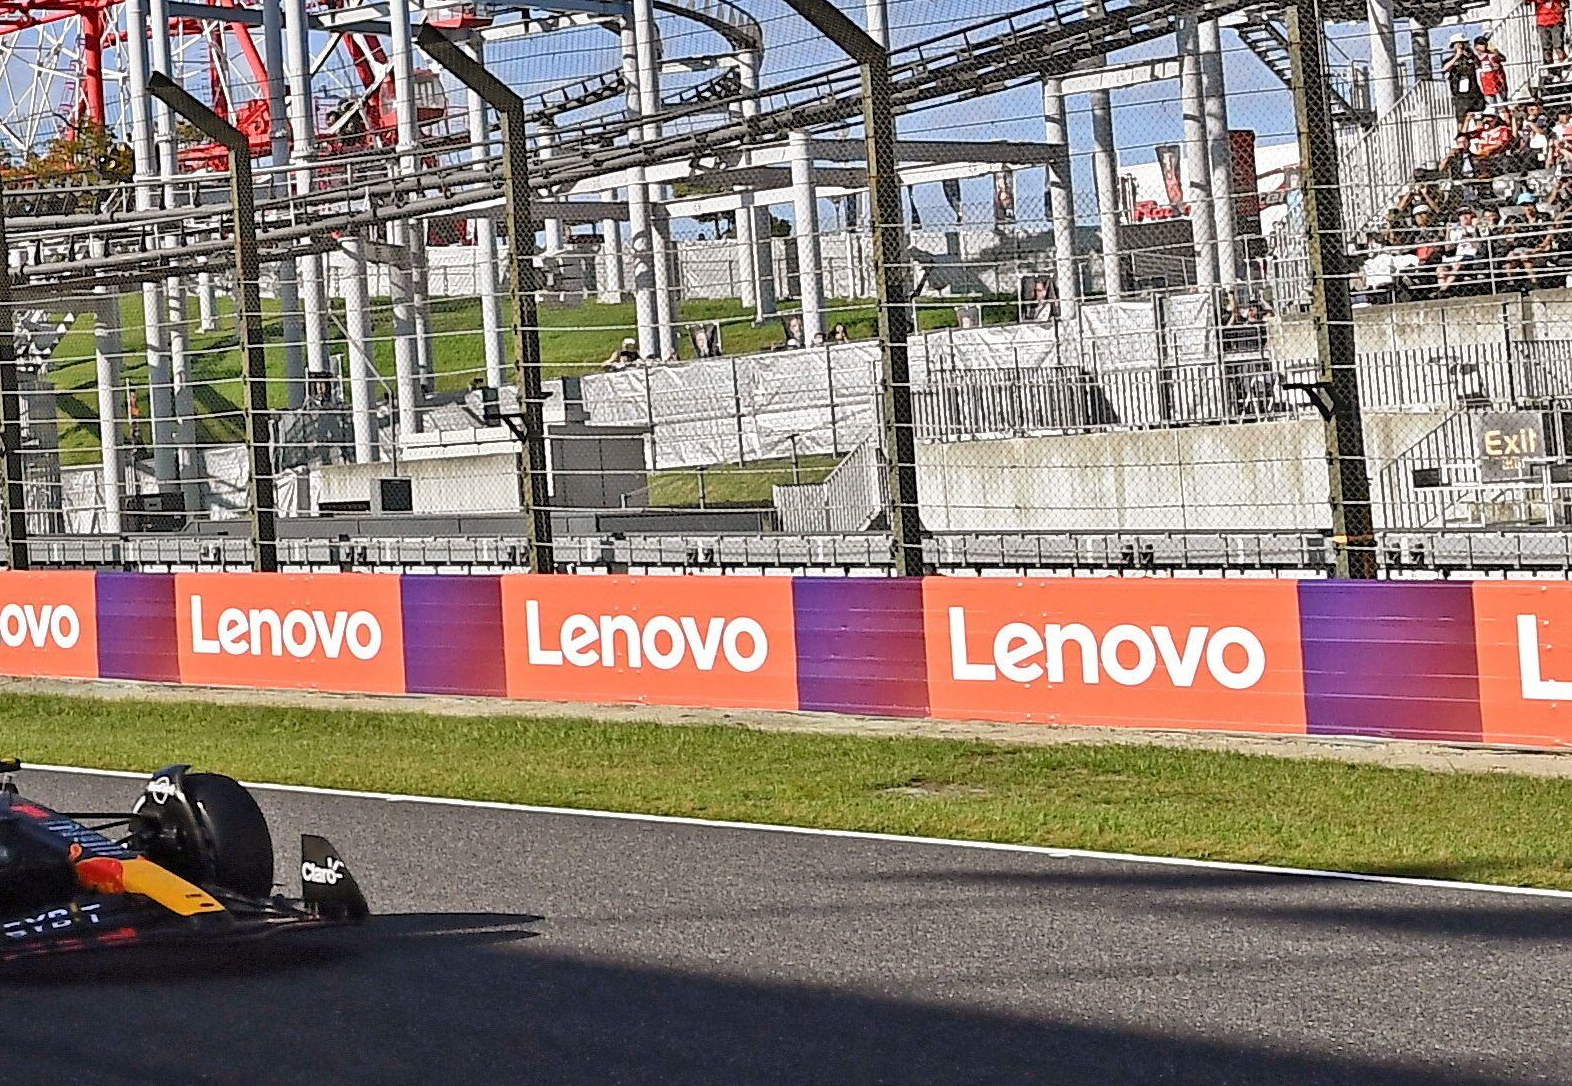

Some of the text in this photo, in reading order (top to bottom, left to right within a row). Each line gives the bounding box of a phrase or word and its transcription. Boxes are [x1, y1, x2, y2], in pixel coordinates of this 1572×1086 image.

[1485, 427, 1537, 455] Exit
[191, 595, 382, 660] Lenovo
[525, 600, 768, 673] Lenovo
[949, 607, 1266, 690] Lenovo
[302, 861, 337, 885] Claro
